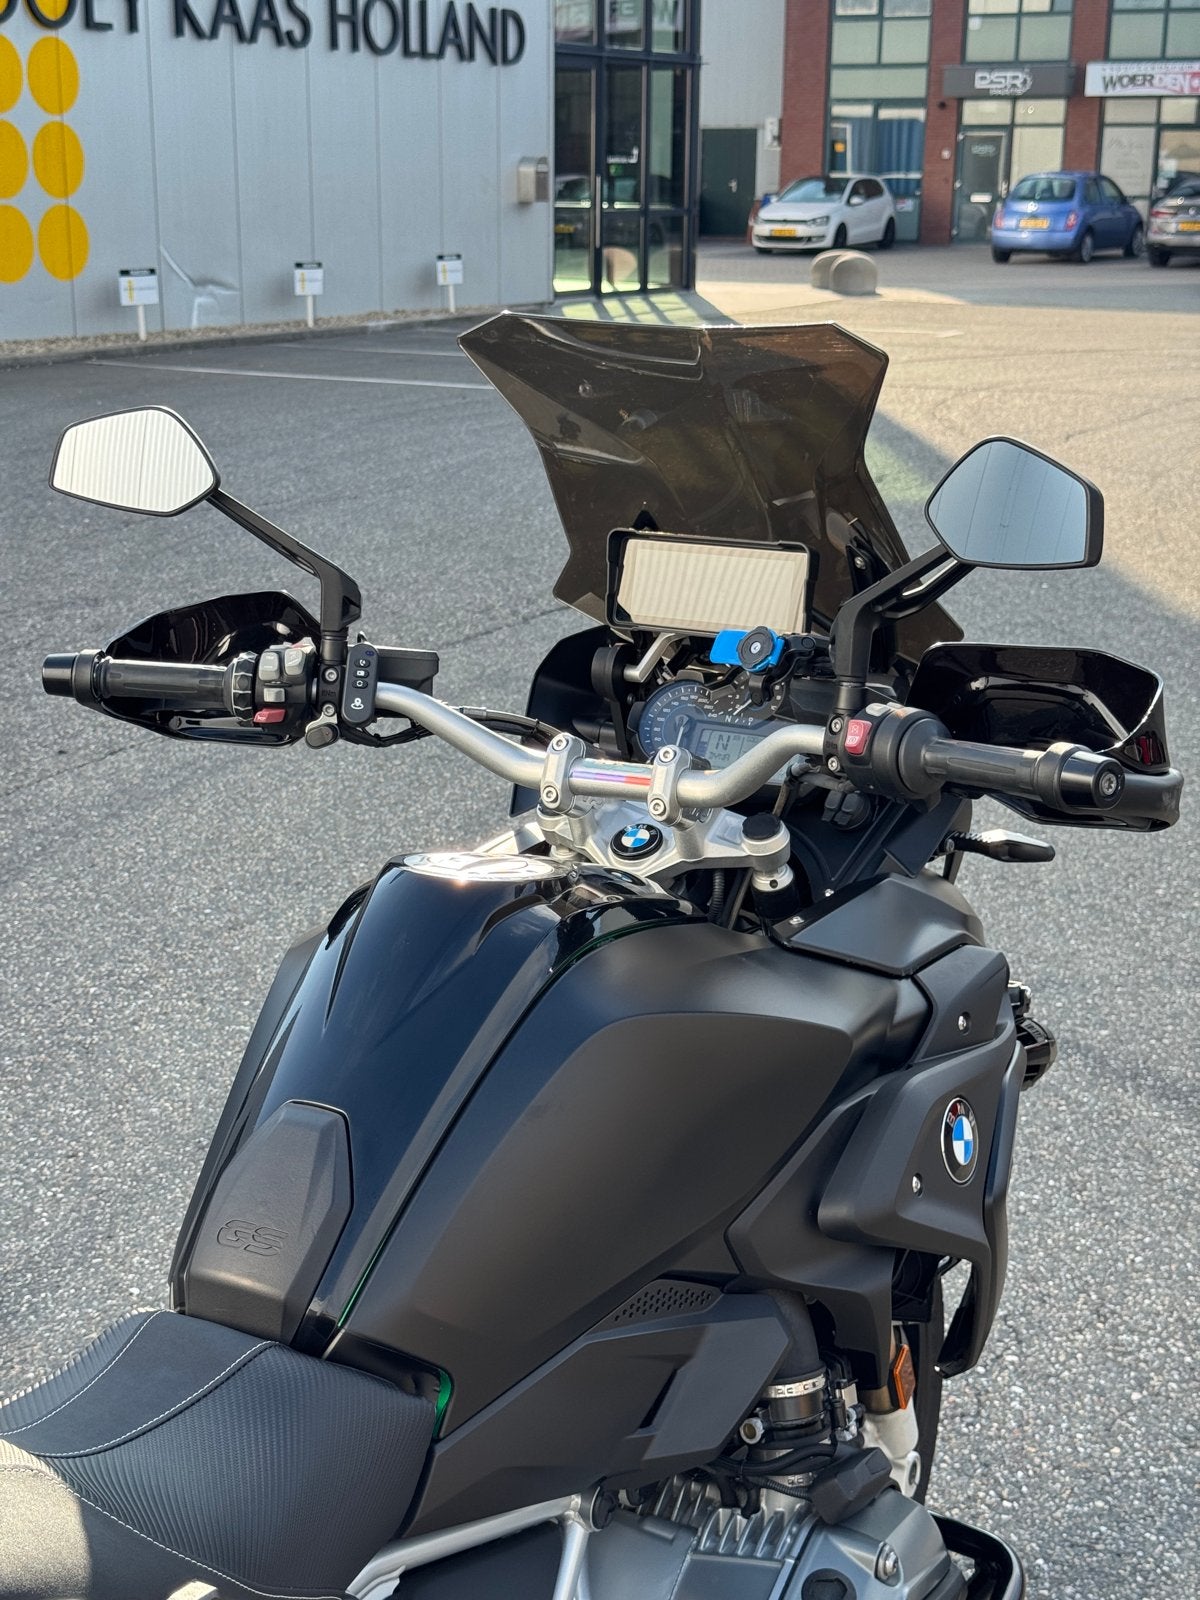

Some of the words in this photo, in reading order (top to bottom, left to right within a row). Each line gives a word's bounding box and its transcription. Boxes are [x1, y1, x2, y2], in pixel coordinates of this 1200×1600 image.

[174, 0, 312, 49] KAAS
[329, 0, 526, 67] HOLLAND
[715, 734, 731, 751] N
[216, 1219, 289, 1257] GS
